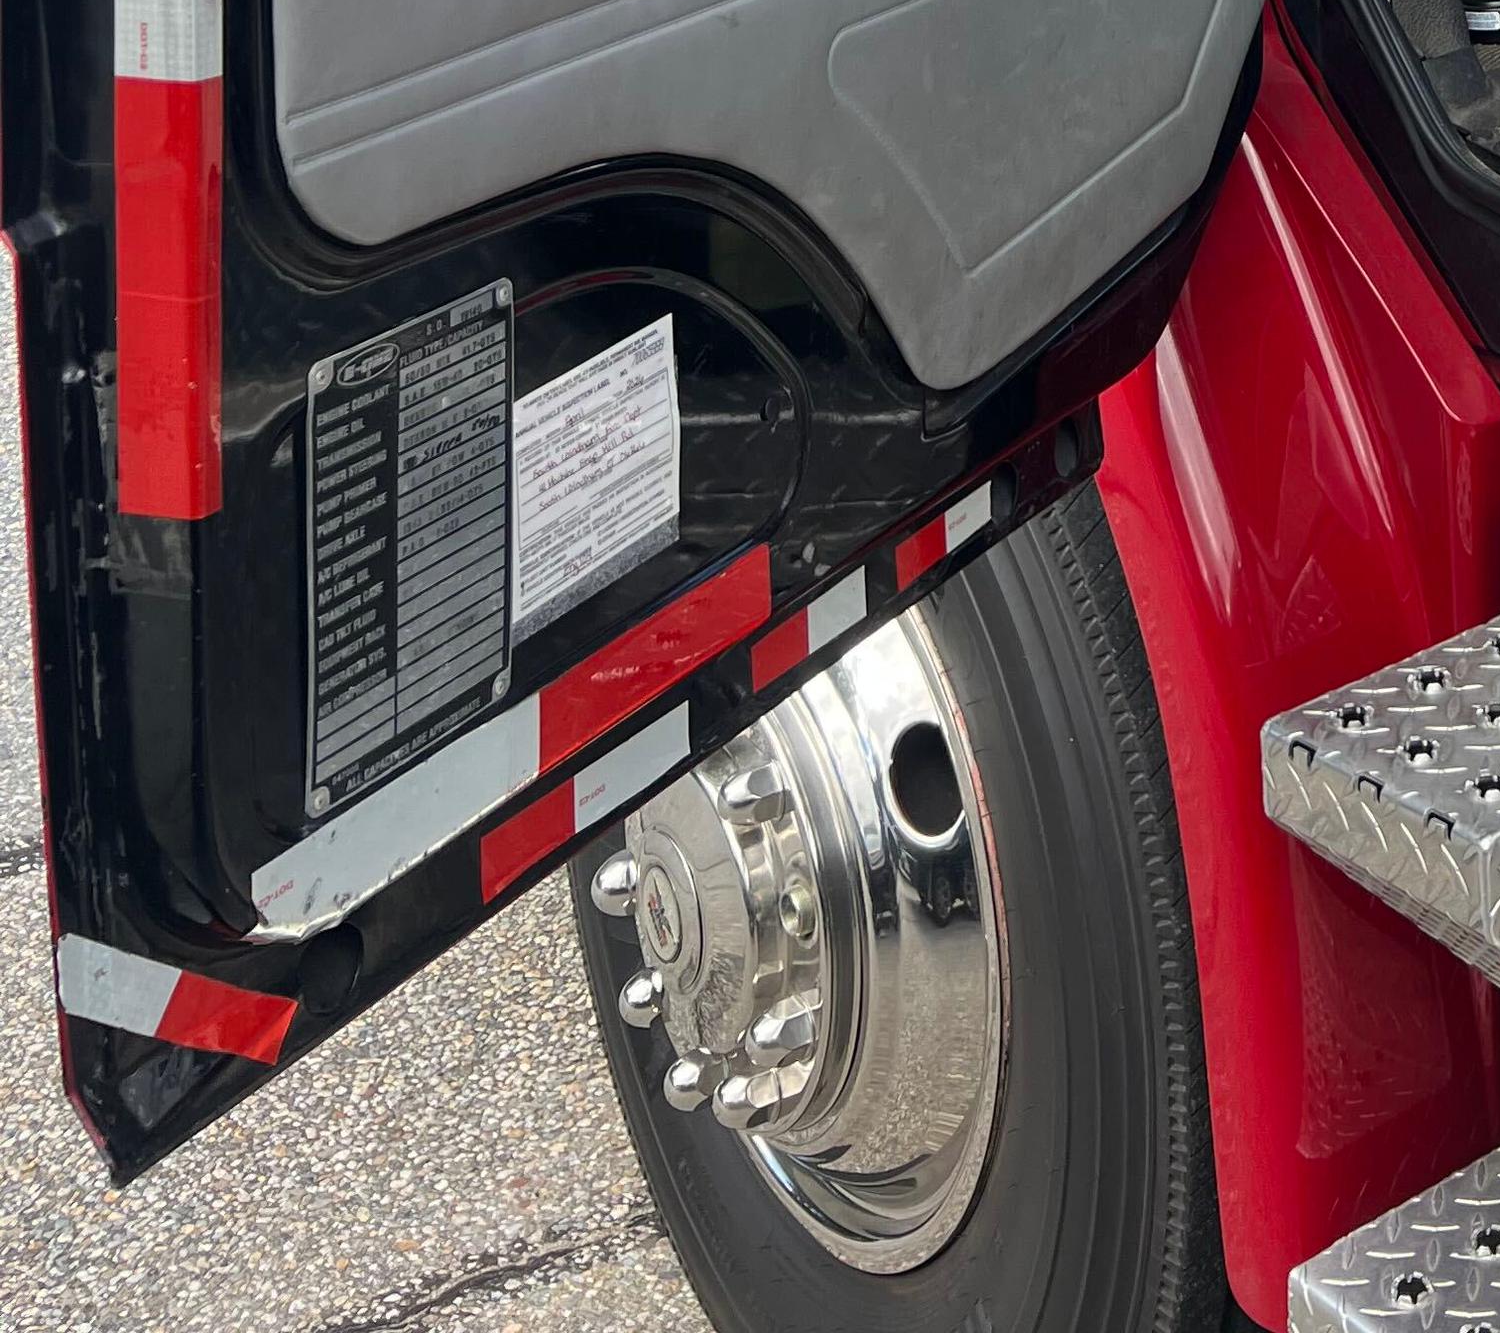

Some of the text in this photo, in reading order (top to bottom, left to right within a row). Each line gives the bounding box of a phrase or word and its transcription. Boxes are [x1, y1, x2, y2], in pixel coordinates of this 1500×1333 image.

[399, 347, 422, 368] FLUID
[351, 382, 389, 411] COOLANT
[317, 429, 381, 471] TRANSMISSION
[317, 468, 346, 494] POWER
[348, 447, 386, 478] STEERING
[317, 493, 341, 517] PUMP
[317, 514, 341, 539] PUMP
[353, 606, 376, 631] FLUID
[318, 655, 366, 697] GENERATOR
[346, 774, 363, 792] ALL
[411, 732, 427, 751] ARE
[428, 696, 482, 740] APPROXIMATE
